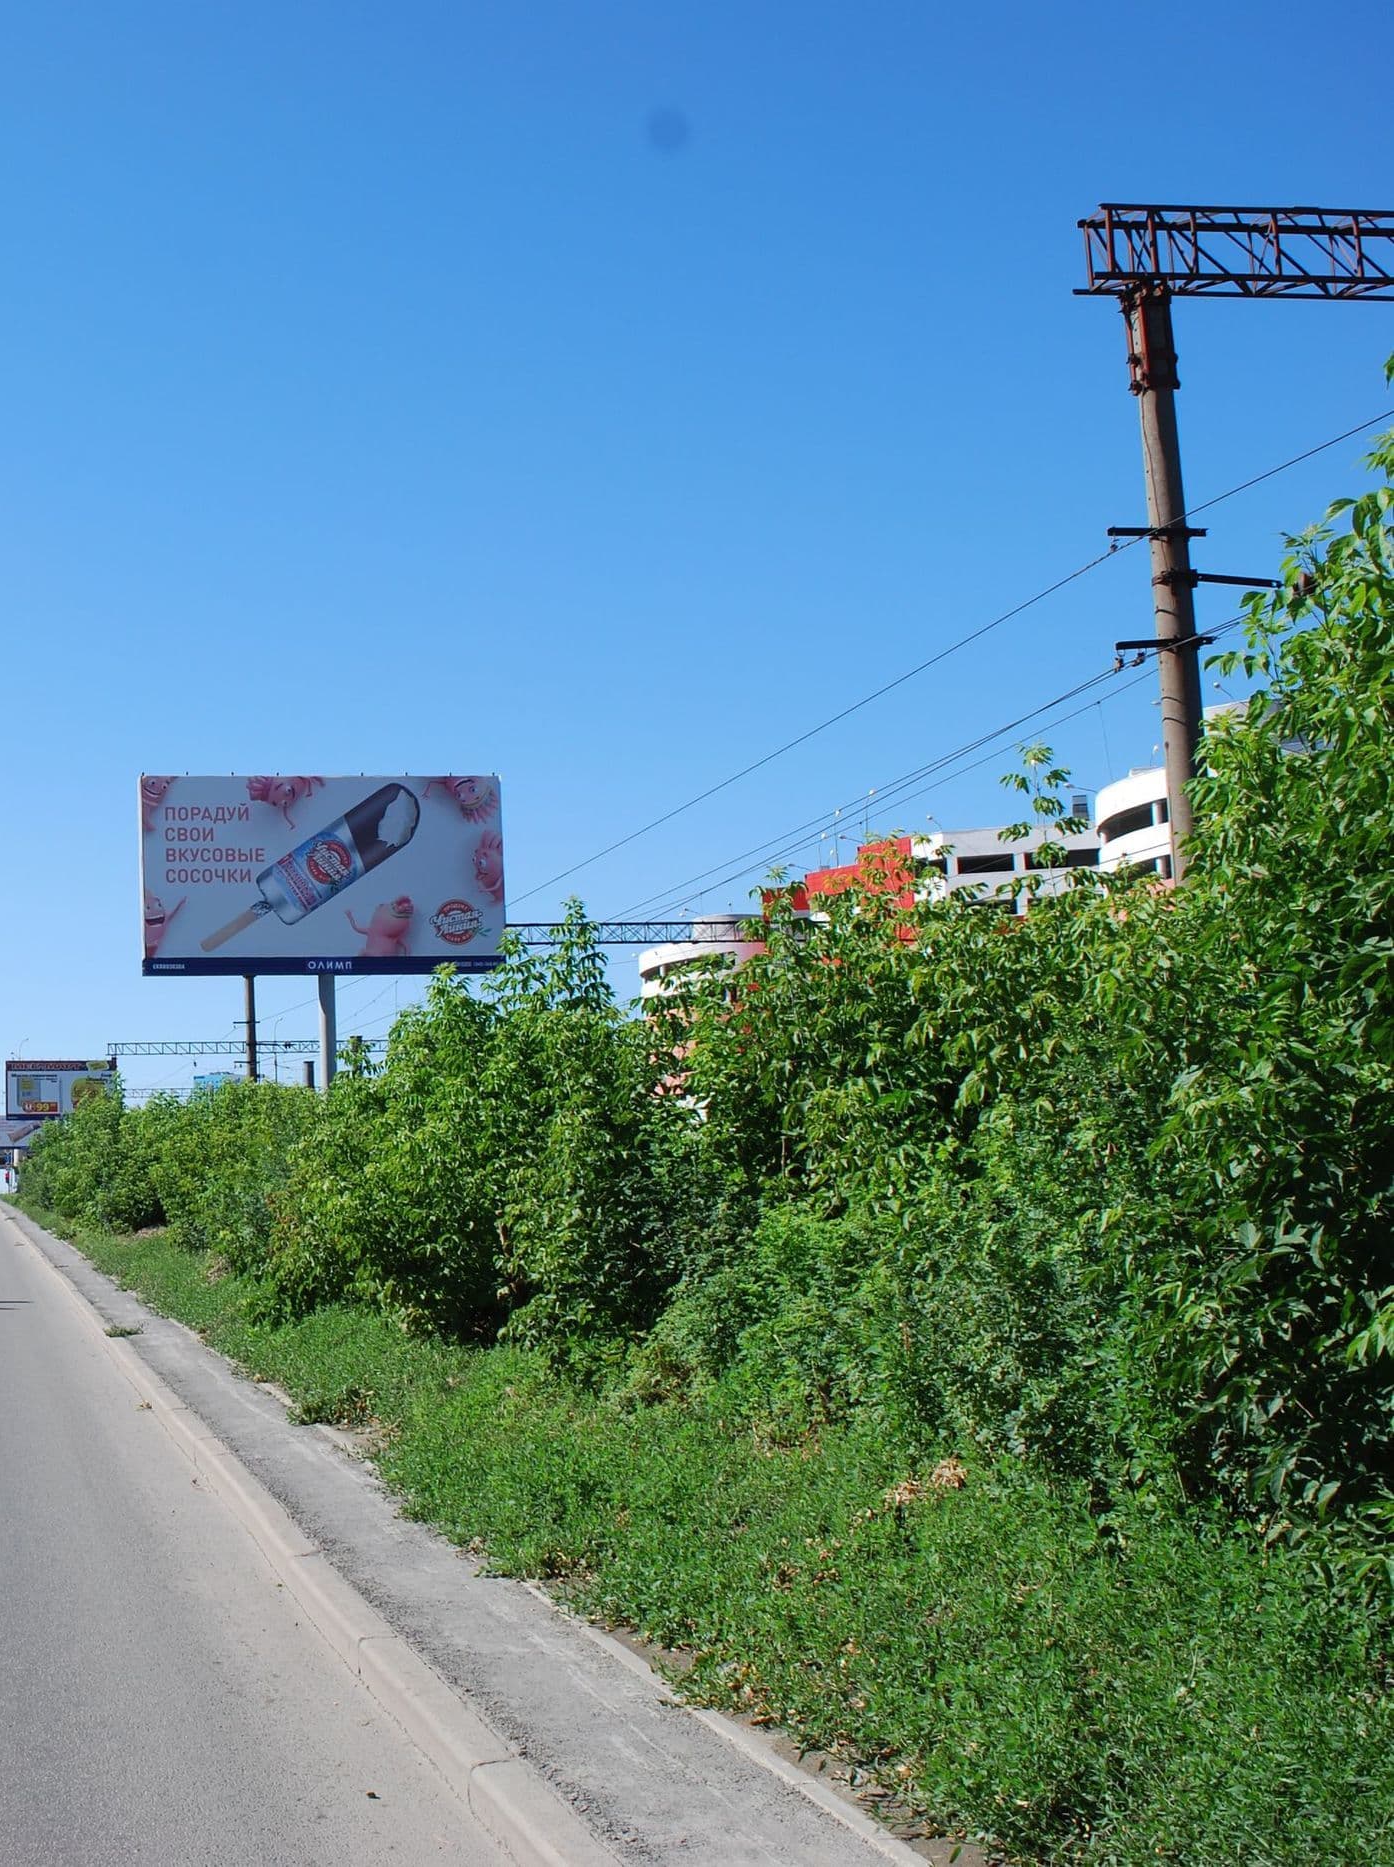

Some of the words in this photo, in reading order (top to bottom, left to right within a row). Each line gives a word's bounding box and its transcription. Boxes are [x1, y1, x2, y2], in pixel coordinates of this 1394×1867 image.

[165, 803, 249, 824] ПОРАДУЙ
[165, 827, 214, 842] СВОИ
[166, 848, 265, 862] ВКУСОВЫЕ
[166, 868, 251, 883] СОСОЧКИ
[308, 961, 352, 970] ОЛИМП
